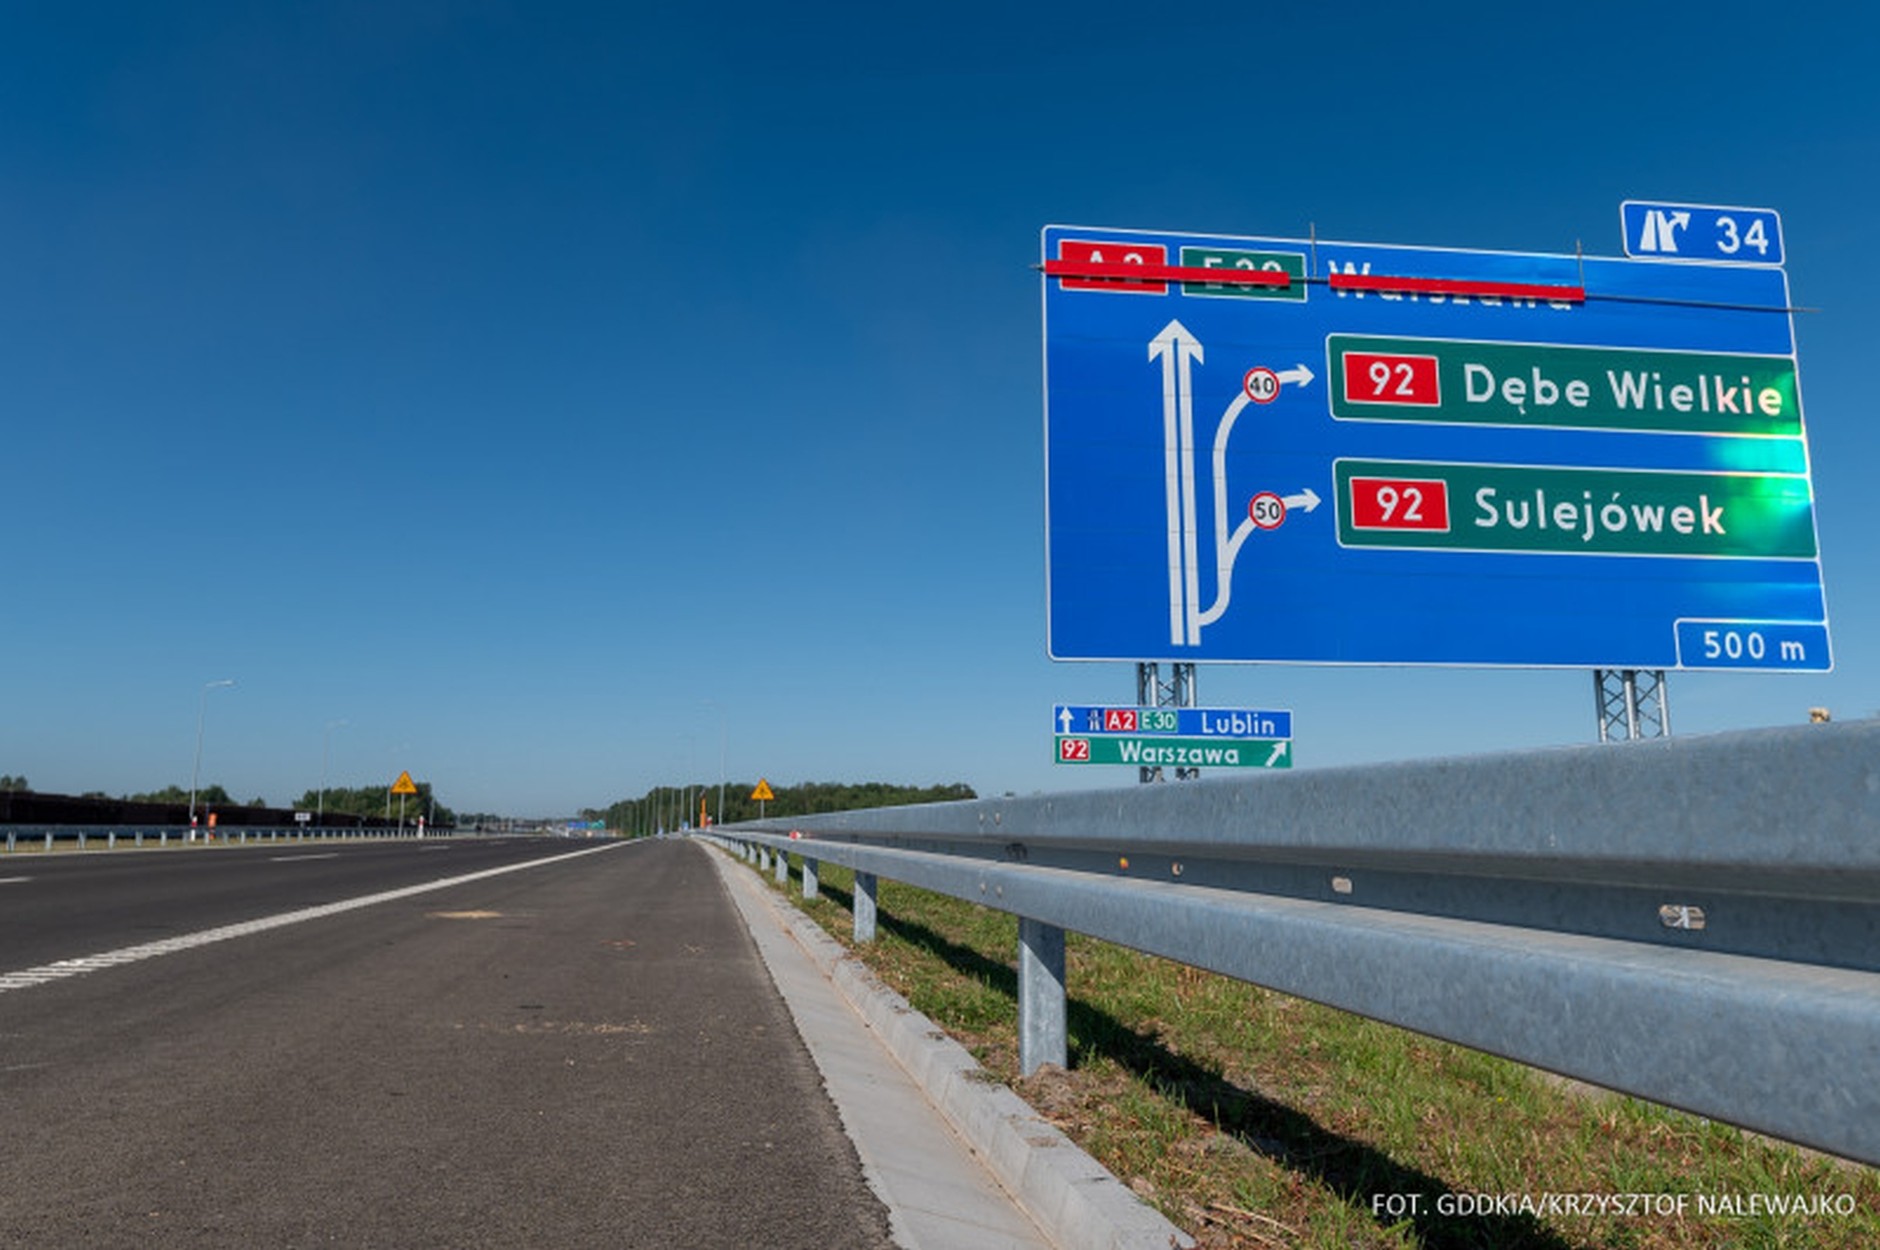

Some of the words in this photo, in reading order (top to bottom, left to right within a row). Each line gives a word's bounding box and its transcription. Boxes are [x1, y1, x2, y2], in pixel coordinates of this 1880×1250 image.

[1716, 216, 1769, 255] 34
[1249, 376, 1275, 394] 40
[1367, 361, 1415, 397] 92
[1463, 362, 1591, 415] Dębe
[1606, 368, 1784, 416] Wielkie
[1255, 502, 1281, 520] 50
[1375, 485, 1424, 522] 92
[1474, 486, 1727, 543] Sulejówek
[1703, 630, 1766, 659] 500
[1780, 641, 1806, 661] m
[1108, 711, 1135, 730] A2
[1202, 712, 1276, 735] Lublin
[1063, 741, 1088, 759] 92
[1118, 740, 1240, 765] Warszawa
